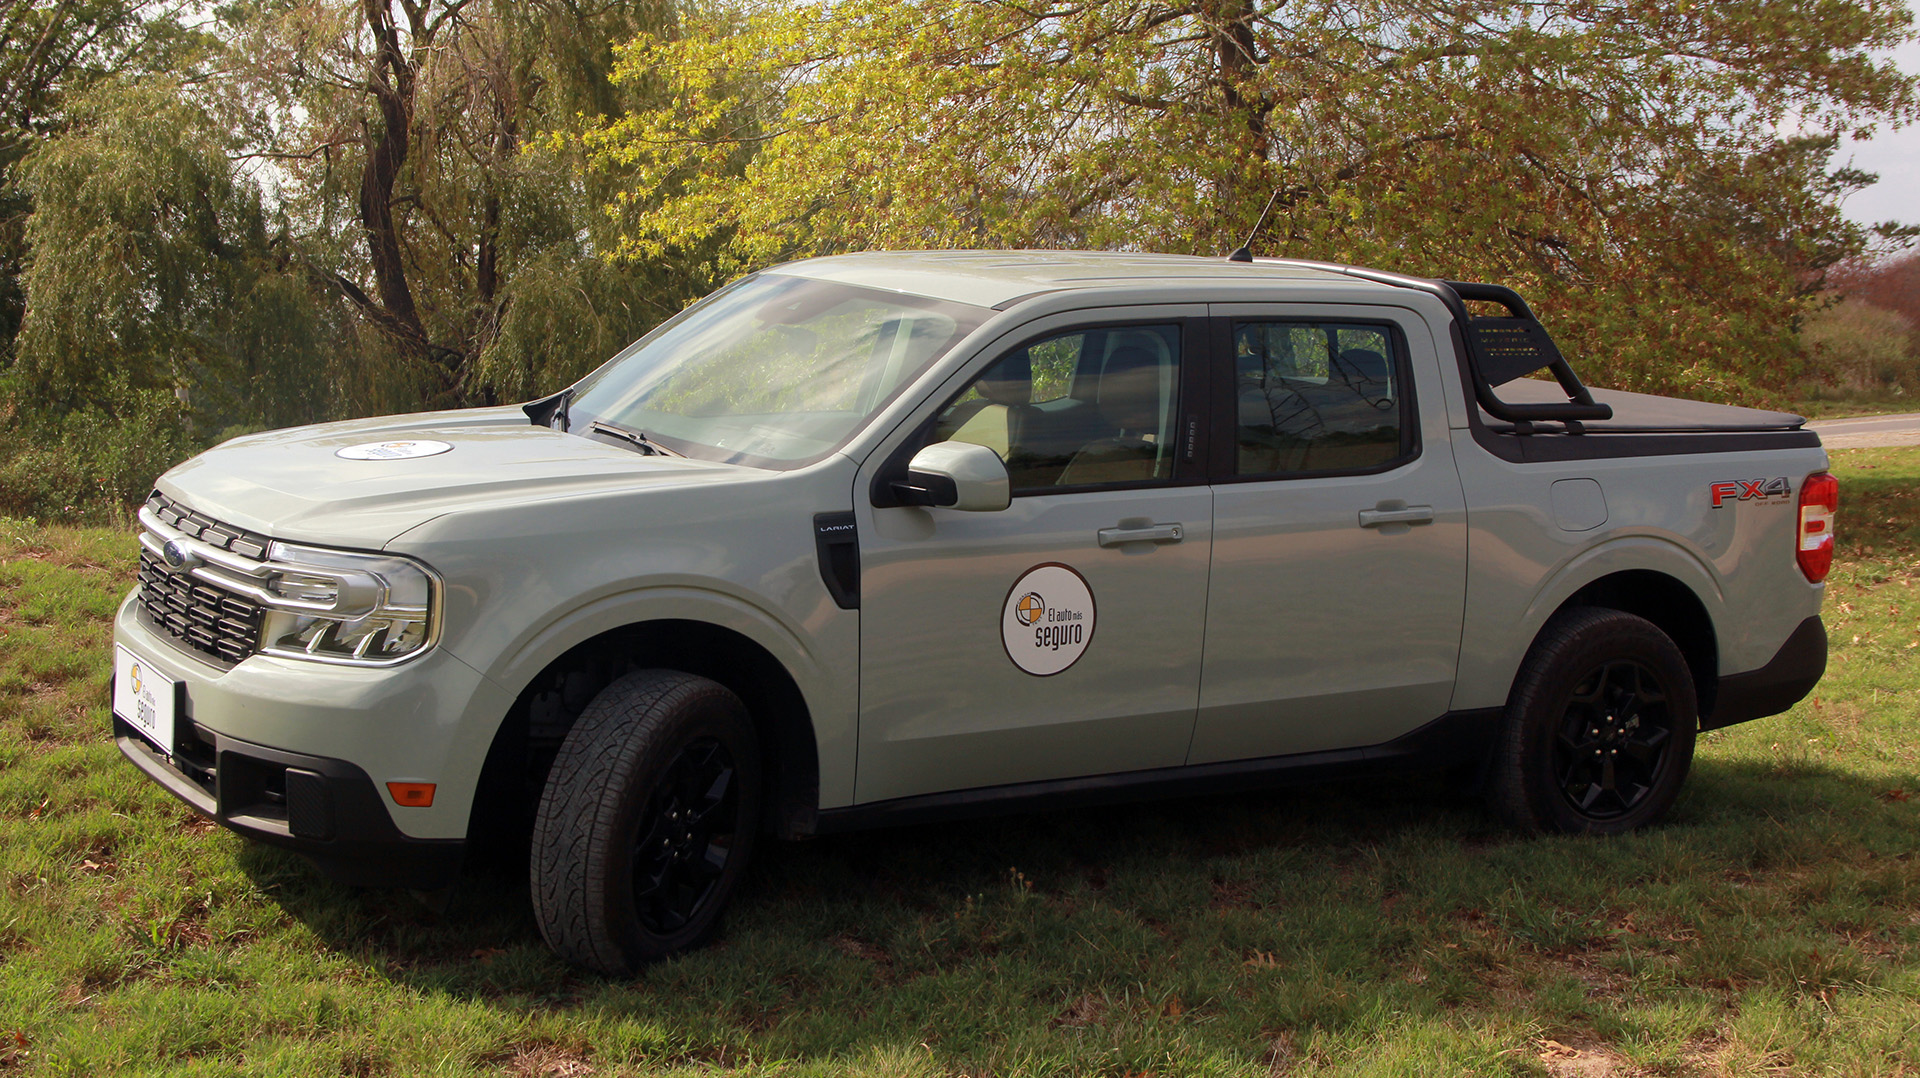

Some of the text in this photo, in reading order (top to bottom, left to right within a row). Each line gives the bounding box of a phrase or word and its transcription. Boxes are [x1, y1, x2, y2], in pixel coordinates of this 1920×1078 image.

[1709, 476, 1791, 509] FX4
[820, 524, 855, 532] LARIAT
[1048, 608, 1055, 622] El
[1056, 609, 1072, 621] auto
[1073, 610, 1083, 620] más
[1035, 624, 1082, 651] seguro
